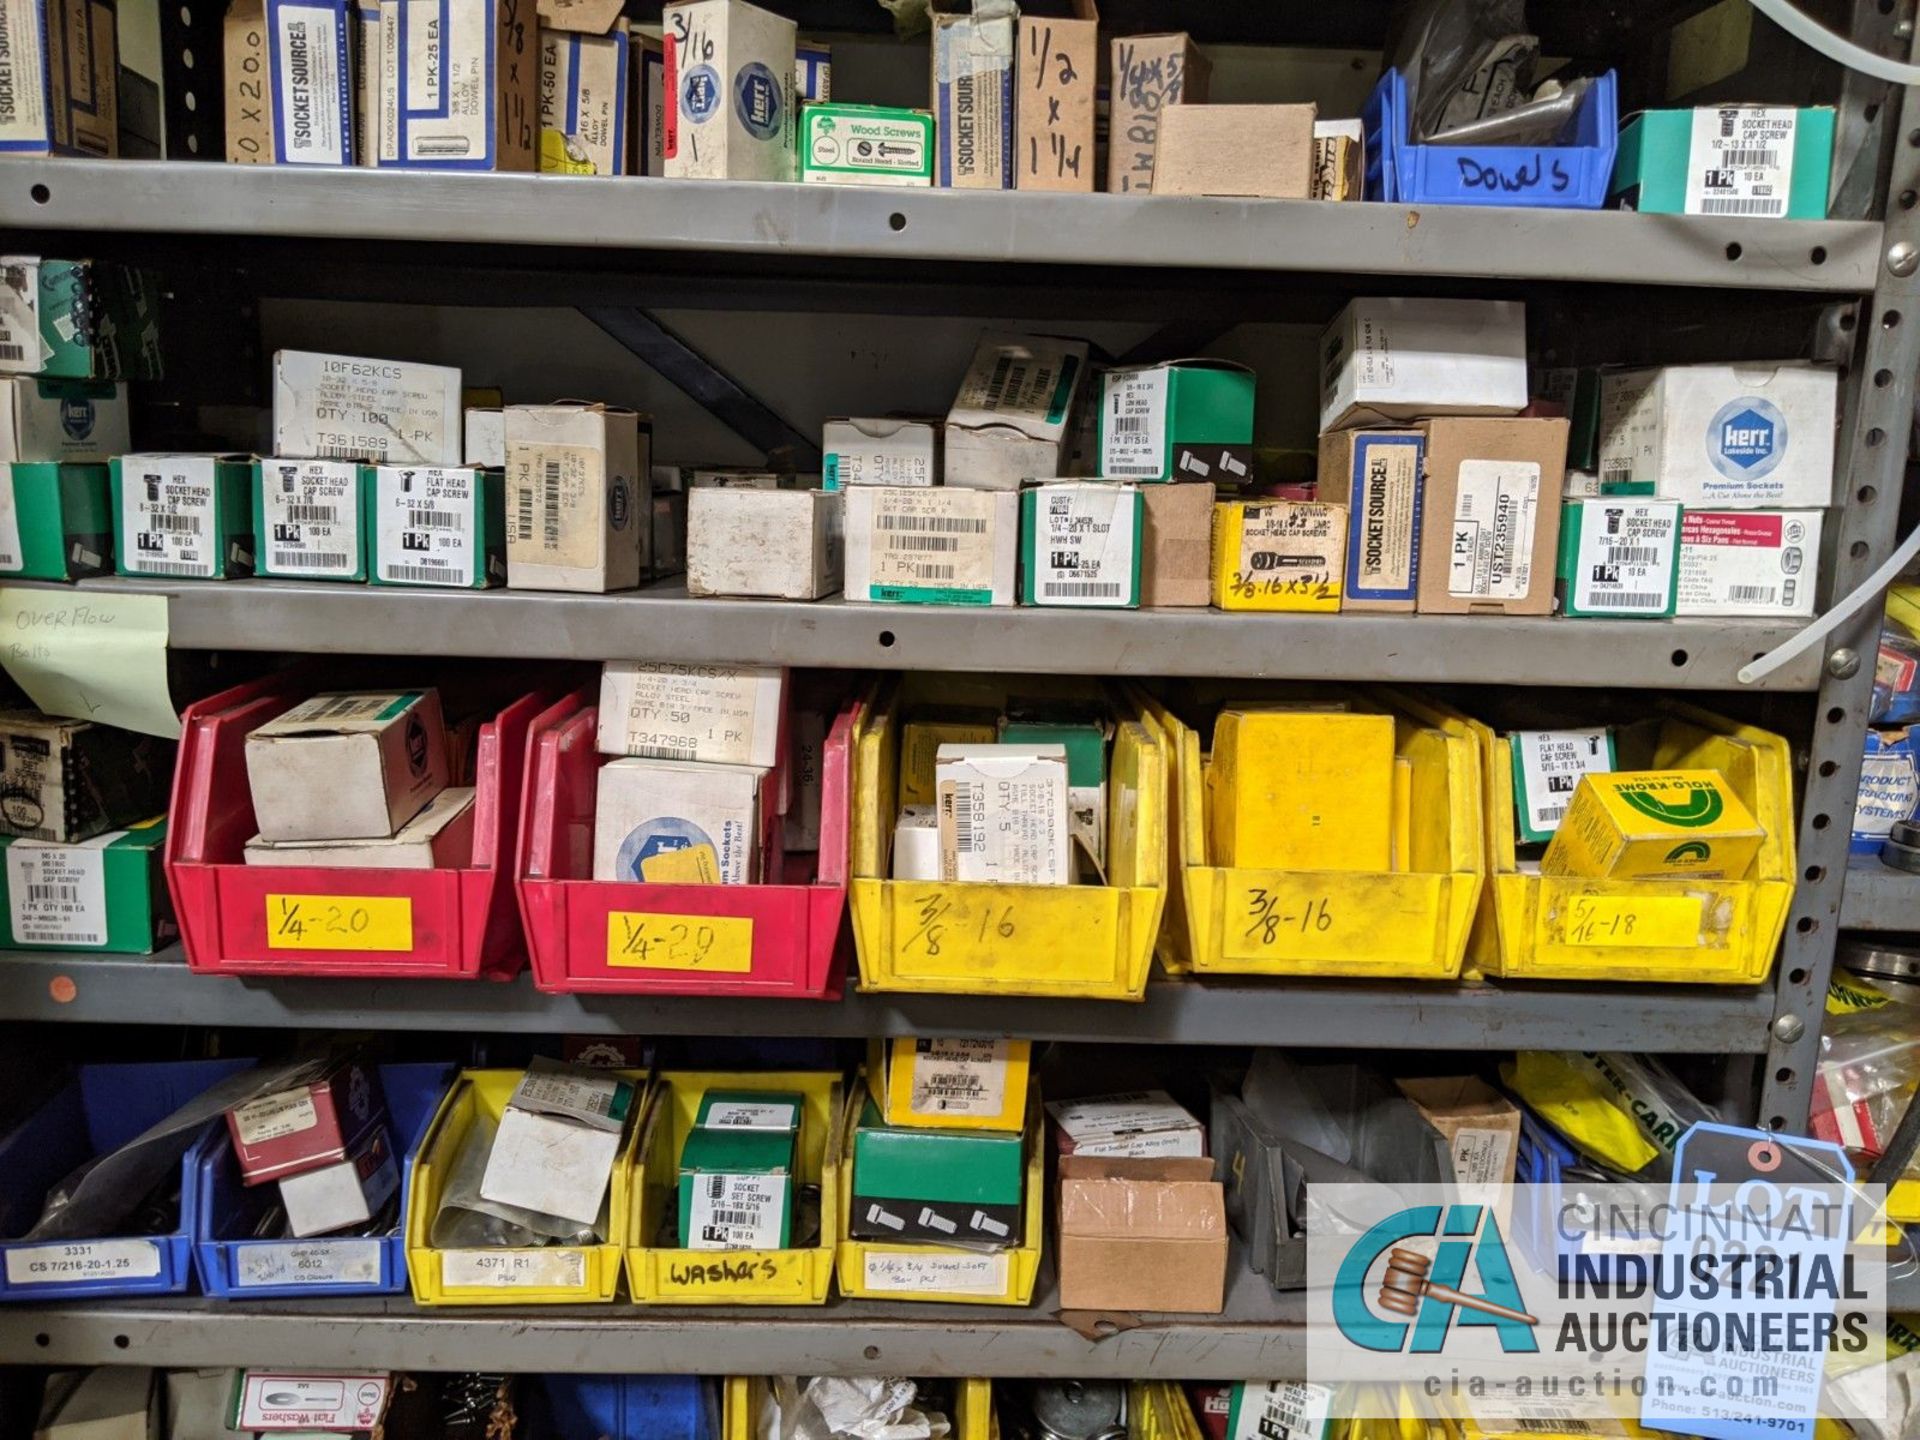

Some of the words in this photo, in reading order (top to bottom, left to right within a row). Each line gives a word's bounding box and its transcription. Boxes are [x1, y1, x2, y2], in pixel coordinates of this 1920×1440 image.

[427, 19, 439, 39] EA
[544, 44, 557, 70] EA
[1031, 25, 1078, 90] 1/2
[427, 44, 439, 86] PK-25
[470, 57, 479, 75] PIN
[461, 83, 470, 115] ALLOY
[470, 76, 479, 116] DOWEL
[542, 70, 556, 116] PK-50
[749, 80, 766, 123] kerr
[601, 101, 609, 116] PIN
[1751, 108, 1766, 117] HEX
[1741, 119, 1772, 130] SOCKET
[1772, 120, 1793, 130] HEAD
[590, 118, 599, 146] ALLOY
[599, 117, 608, 147] DOWEL
[850, 124, 881, 136] Wood
[883, 126, 922, 138] Screws
[1742, 130, 1757, 140] CAP
[1759, 130, 1788, 140] SCREW
[1756, 140, 1768, 149] 1/2
[1753, 172, 1764, 182] EA
[323, 360, 402, 380] 10F62KCS
[317, 432, 388, 449] T361589
[414, 430, 433, 442] PK
[1724, 425, 1770, 447] kerr
[1724, 447, 1754, 455] Lakeside
[309, 465, 323, 475] HEX
[519, 463, 530, 482] PK
[873, 455, 884, 482] QTY
[172, 475, 186, 484] HEX
[301, 475, 329, 486] SOCKET
[329, 477, 348, 487] HEAD
[426, 477, 445, 488] FLAT
[446, 478, 467, 489] HEAD
[165, 485, 191, 496] SOCKET
[191, 486, 211, 497] HEAD
[303, 486, 317, 496] CAP
[319, 486, 344, 497] SCREW
[1703, 482, 1743, 491] Premium
[1746, 482, 1784, 491] Sockets
[426, 487, 441, 498] CAP
[442, 488, 469, 499] SCREW
[1717, 491, 1730, 499] Cut
[1753, 491, 1764, 499] the
[1765, 491, 1784, 499] Best!
[167, 496, 180, 506] CAP
[181, 497, 208, 507] SCREW
[1634, 508, 1648, 517] HEX
[1092, 525, 1110, 534] SLOT
[1626, 519, 1652, 529] SOCKET
[1652, 519, 1672, 529] HEAD
[309, 527, 321, 536] 100
[321, 527, 332, 537] EA
[1270, 529, 1287, 537] HEAD
[1302, 529, 1327, 537] SCREWS
[1627, 528, 1642, 538] CAP
[1643, 529, 1668, 538] SCREW
[171, 536, 183, 546] 100
[184, 537, 194, 547] EA
[438, 537, 451, 548] 100
[452, 538, 463, 548] EA
[1069, 536, 1082, 545] SW
[1455, 530, 1468, 554] PK
[1491, 494, 1510, 584] UST235940
[1713, 535, 1730, 544] Pans
[896, 561, 915, 573] PK
[1606, 566, 1619, 581] Pk
[1627, 567, 1635, 577] 10
[1636, 568, 1646, 577] EA
[635, 690, 661, 700] ALLOY
[665, 693, 690, 703] STEEL
[636, 683, 666, 692] SOCKET
[670, 685, 692, 694] HEAD
[715, 691, 742, 700] SCREW
[629, 730, 698, 749] T347968
[723, 729, 744, 743] PK
[1540, 743, 1555, 752] FLAT
[1556, 742, 1575, 751] HEAD
[1540, 753, 1553, 762] CAP
[1554, 752, 1577, 761] SCREW
[1029, 784, 1037, 814] SOCKET
[1857, 804, 1906, 819] YSTEMS
[972, 783, 986, 853] T358192
[733, 820, 743, 843] Best!
[1029, 818, 1037, 840] HEAD
[720, 820, 732, 867] Sockets
[733, 845, 743, 858] the
[1029, 845, 1037, 860] CAP
[42, 868, 67, 876] SOCKET
[42, 876, 56, 884] CAP
[57, 876, 80, 884] SCREW
[27, 904, 38, 912] PK
[43, 904, 59, 913] QTY
[61, 904, 74, 912] 100
[75, 904, 85, 913] EA
[1459, 1148, 1470, 1162] PK
[733, 1183, 760, 1192] SOCKET
[731, 1192, 745, 1201] SET
[747, 1194, 772, 1203] SCREW
[744, 1232, 755, 1241] EA
[64, 1246, 93, 1256] 3331
[30, 1261, 48, 1272] CS
[298, 1260, 323, 1269] 6012
[475, 1258, 506, 1269] 4371
[513, 1258, 531, 1268] R1
[1718, 1357, 1816, 1384] AUCTIONEERS
[1651, 1398, 1697, 1415] Phone:
[262, 1412, 311, 1424] Washers
[314, 1413, 336, 1423] Flat
